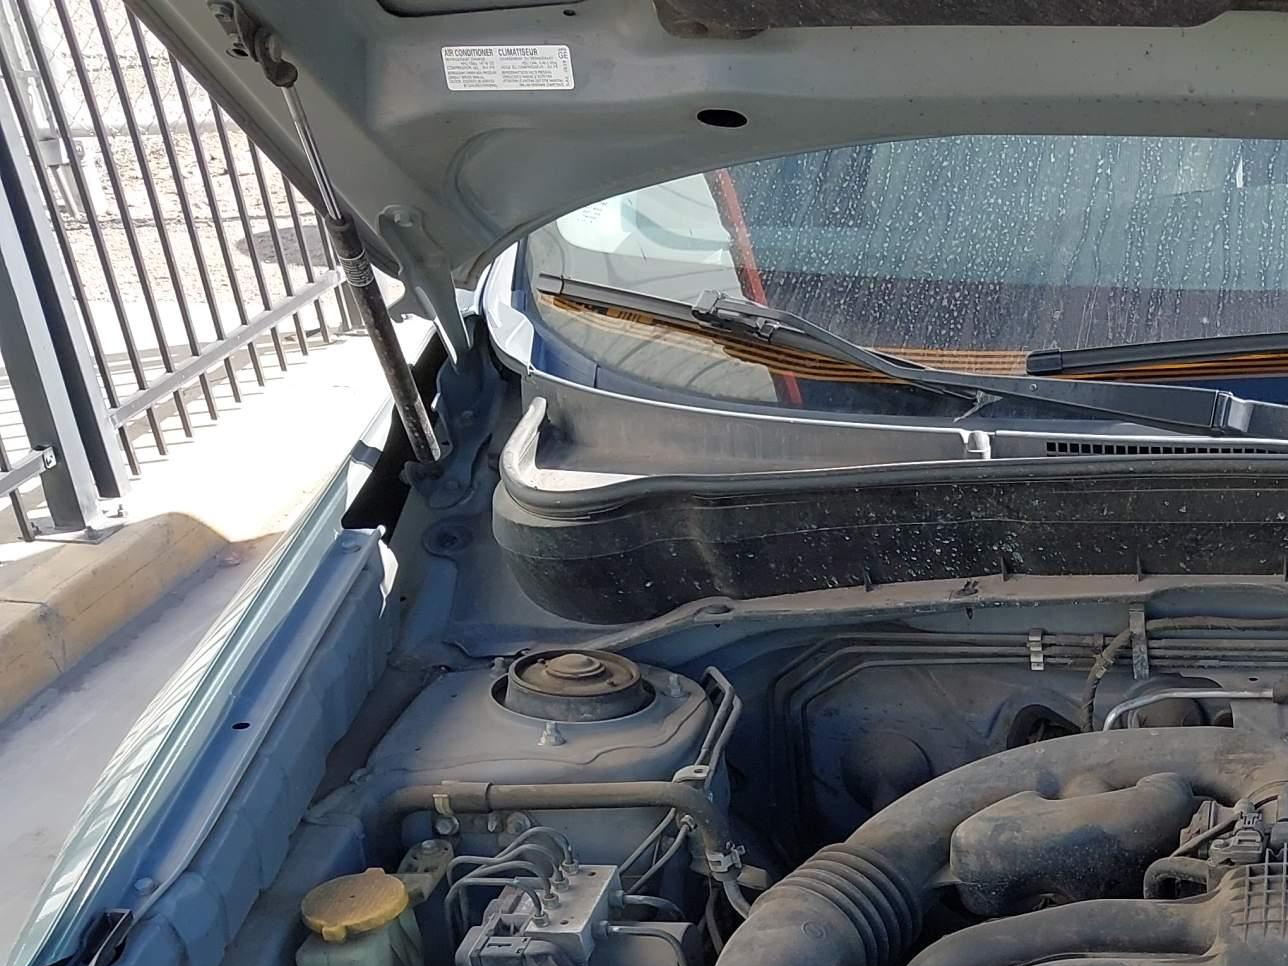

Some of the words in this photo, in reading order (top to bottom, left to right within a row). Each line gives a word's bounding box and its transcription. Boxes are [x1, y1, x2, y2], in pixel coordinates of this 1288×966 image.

[444, 49, 454, 57] AIR
[454, 48, 494, 57] CONDITIONER
[497, 48, 538, 57] CLIMATISEUR
[558, 51, 569, 60] GE
